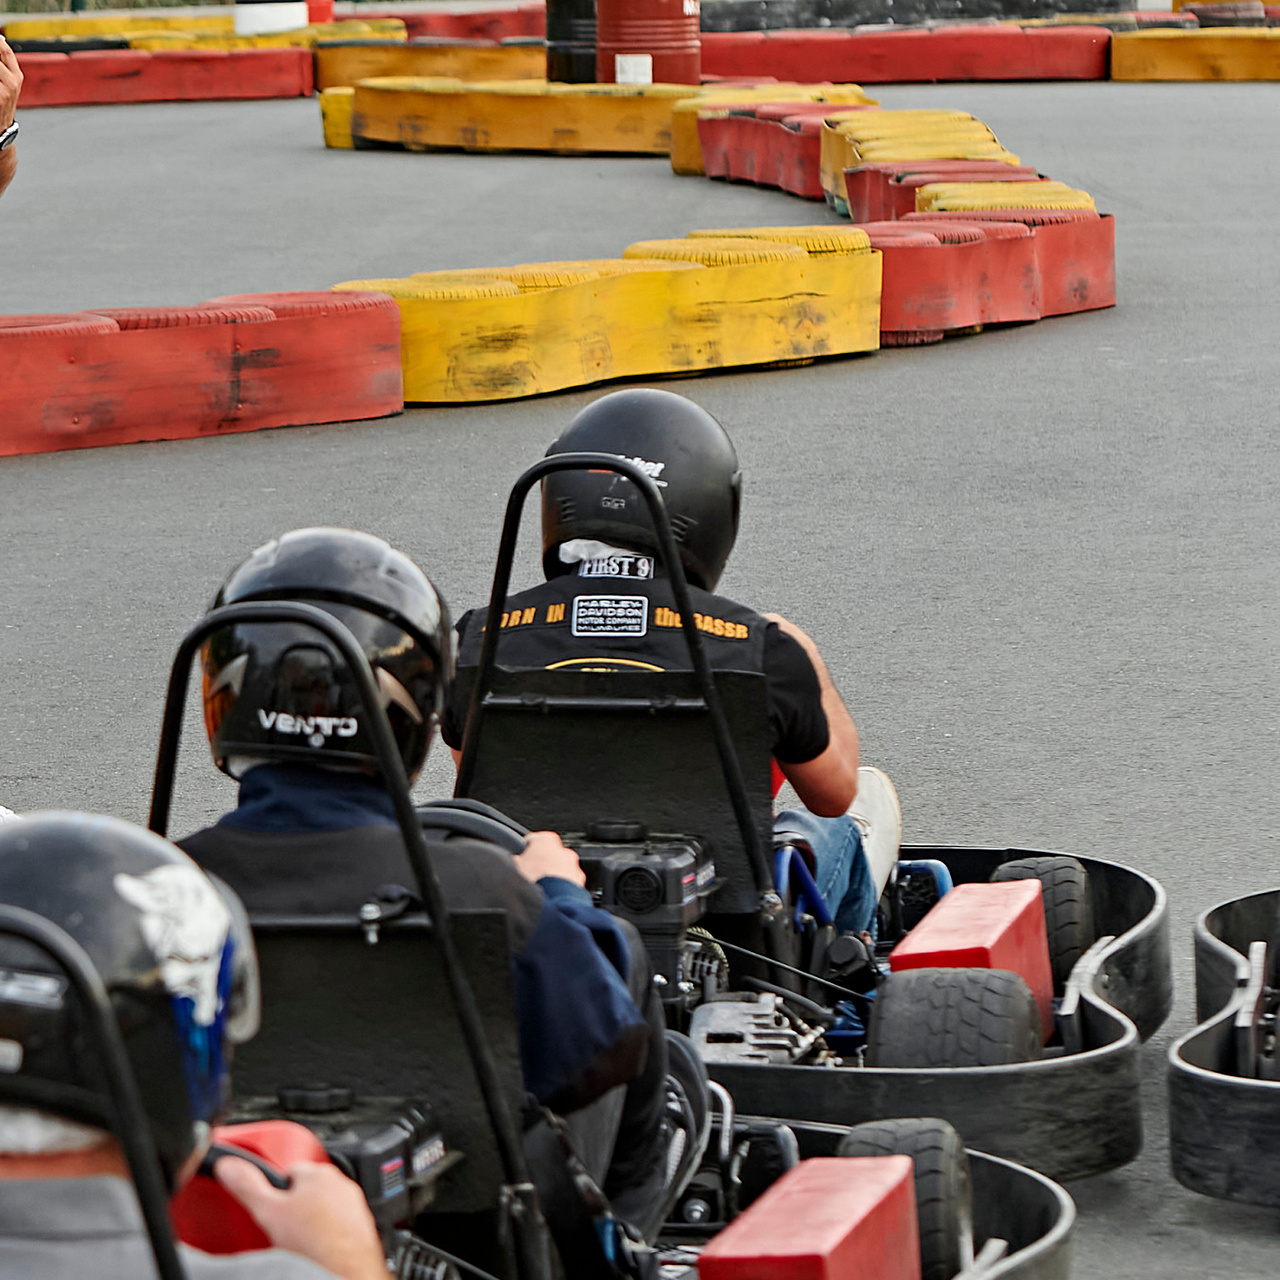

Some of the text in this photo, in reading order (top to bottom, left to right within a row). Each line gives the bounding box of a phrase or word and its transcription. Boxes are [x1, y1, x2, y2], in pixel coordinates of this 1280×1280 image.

[583, 557, 650, 577] FIRST 9
[546, 603, 566, 623] IN
[578, 608, 643, 617] DAVIDSON
[257, 708, 358, 737] VENTO
